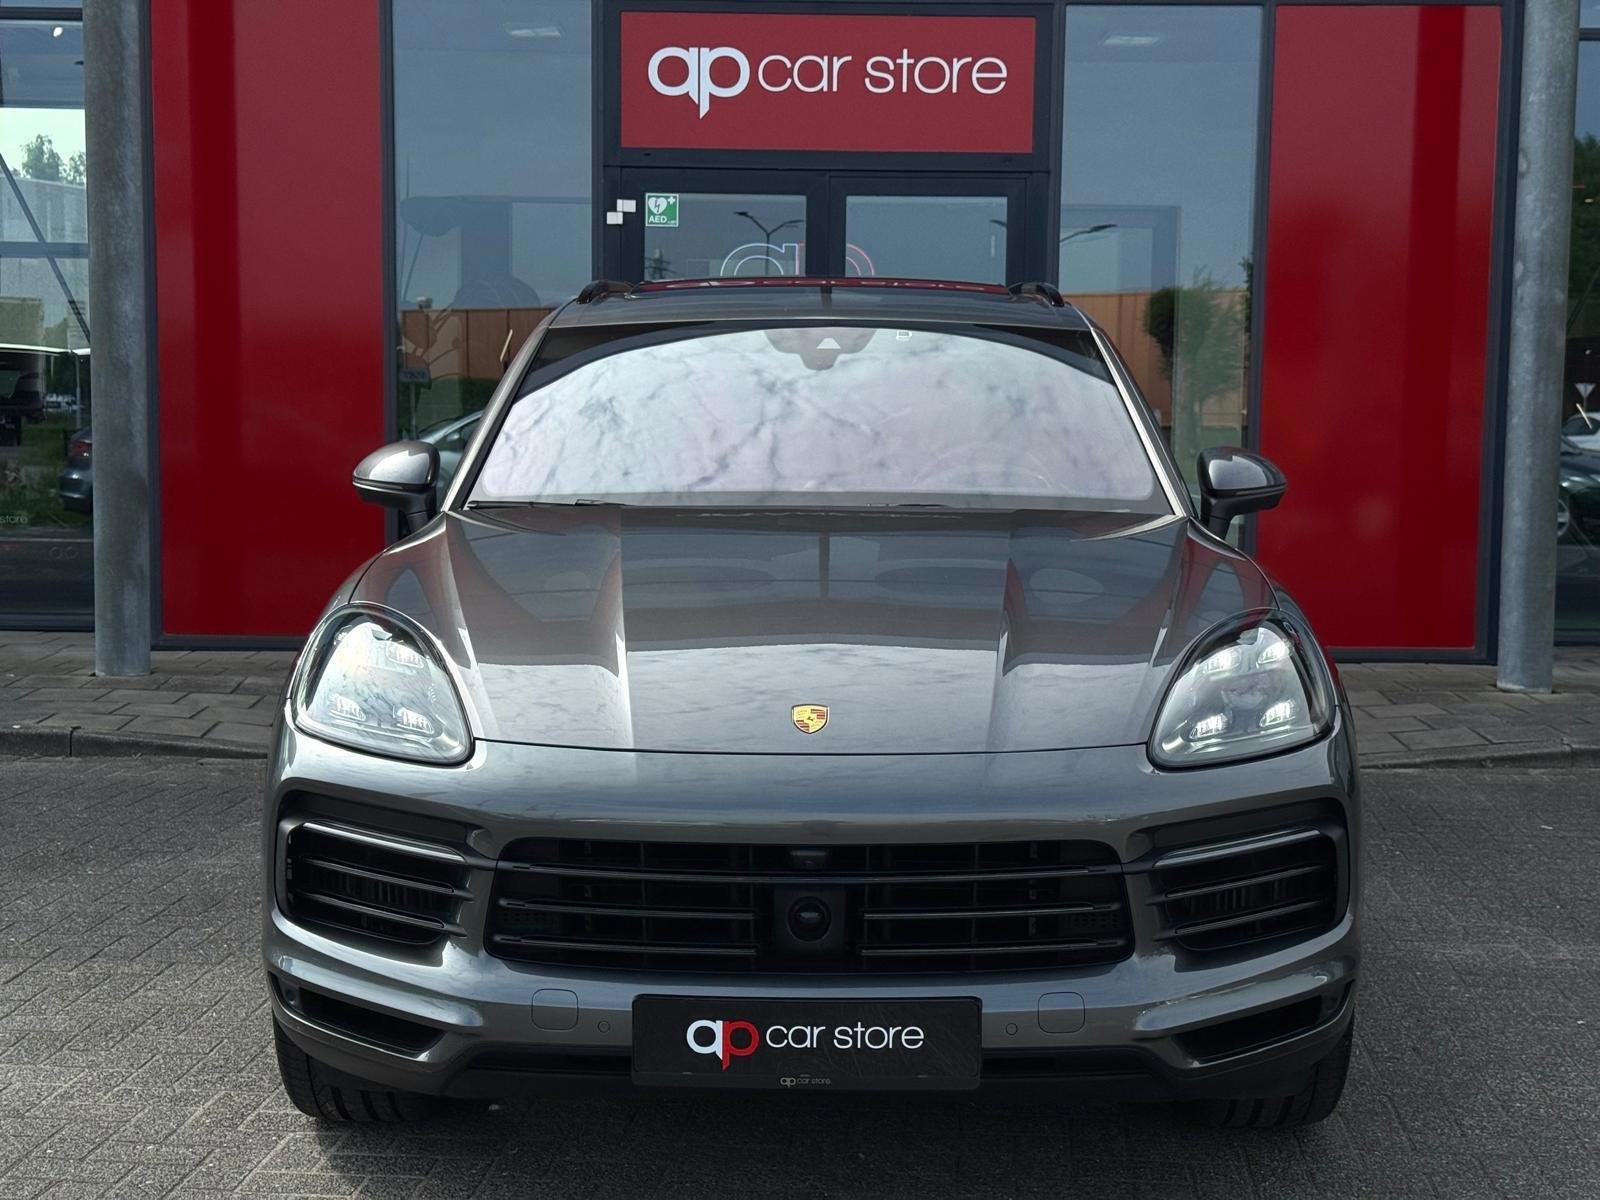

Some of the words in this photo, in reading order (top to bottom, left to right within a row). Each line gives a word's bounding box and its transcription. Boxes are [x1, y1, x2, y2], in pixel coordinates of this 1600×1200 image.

[648, 46, 750, 119] ap
[758, 54, 852, 93] car
[864, 48, 1008, 95] store
[649, 215, 667, 223] AED
[686, 1019, 760, 1071] ap
[765, 1025, 826, 1048] car
[833, 1022, 924, 1050] store
